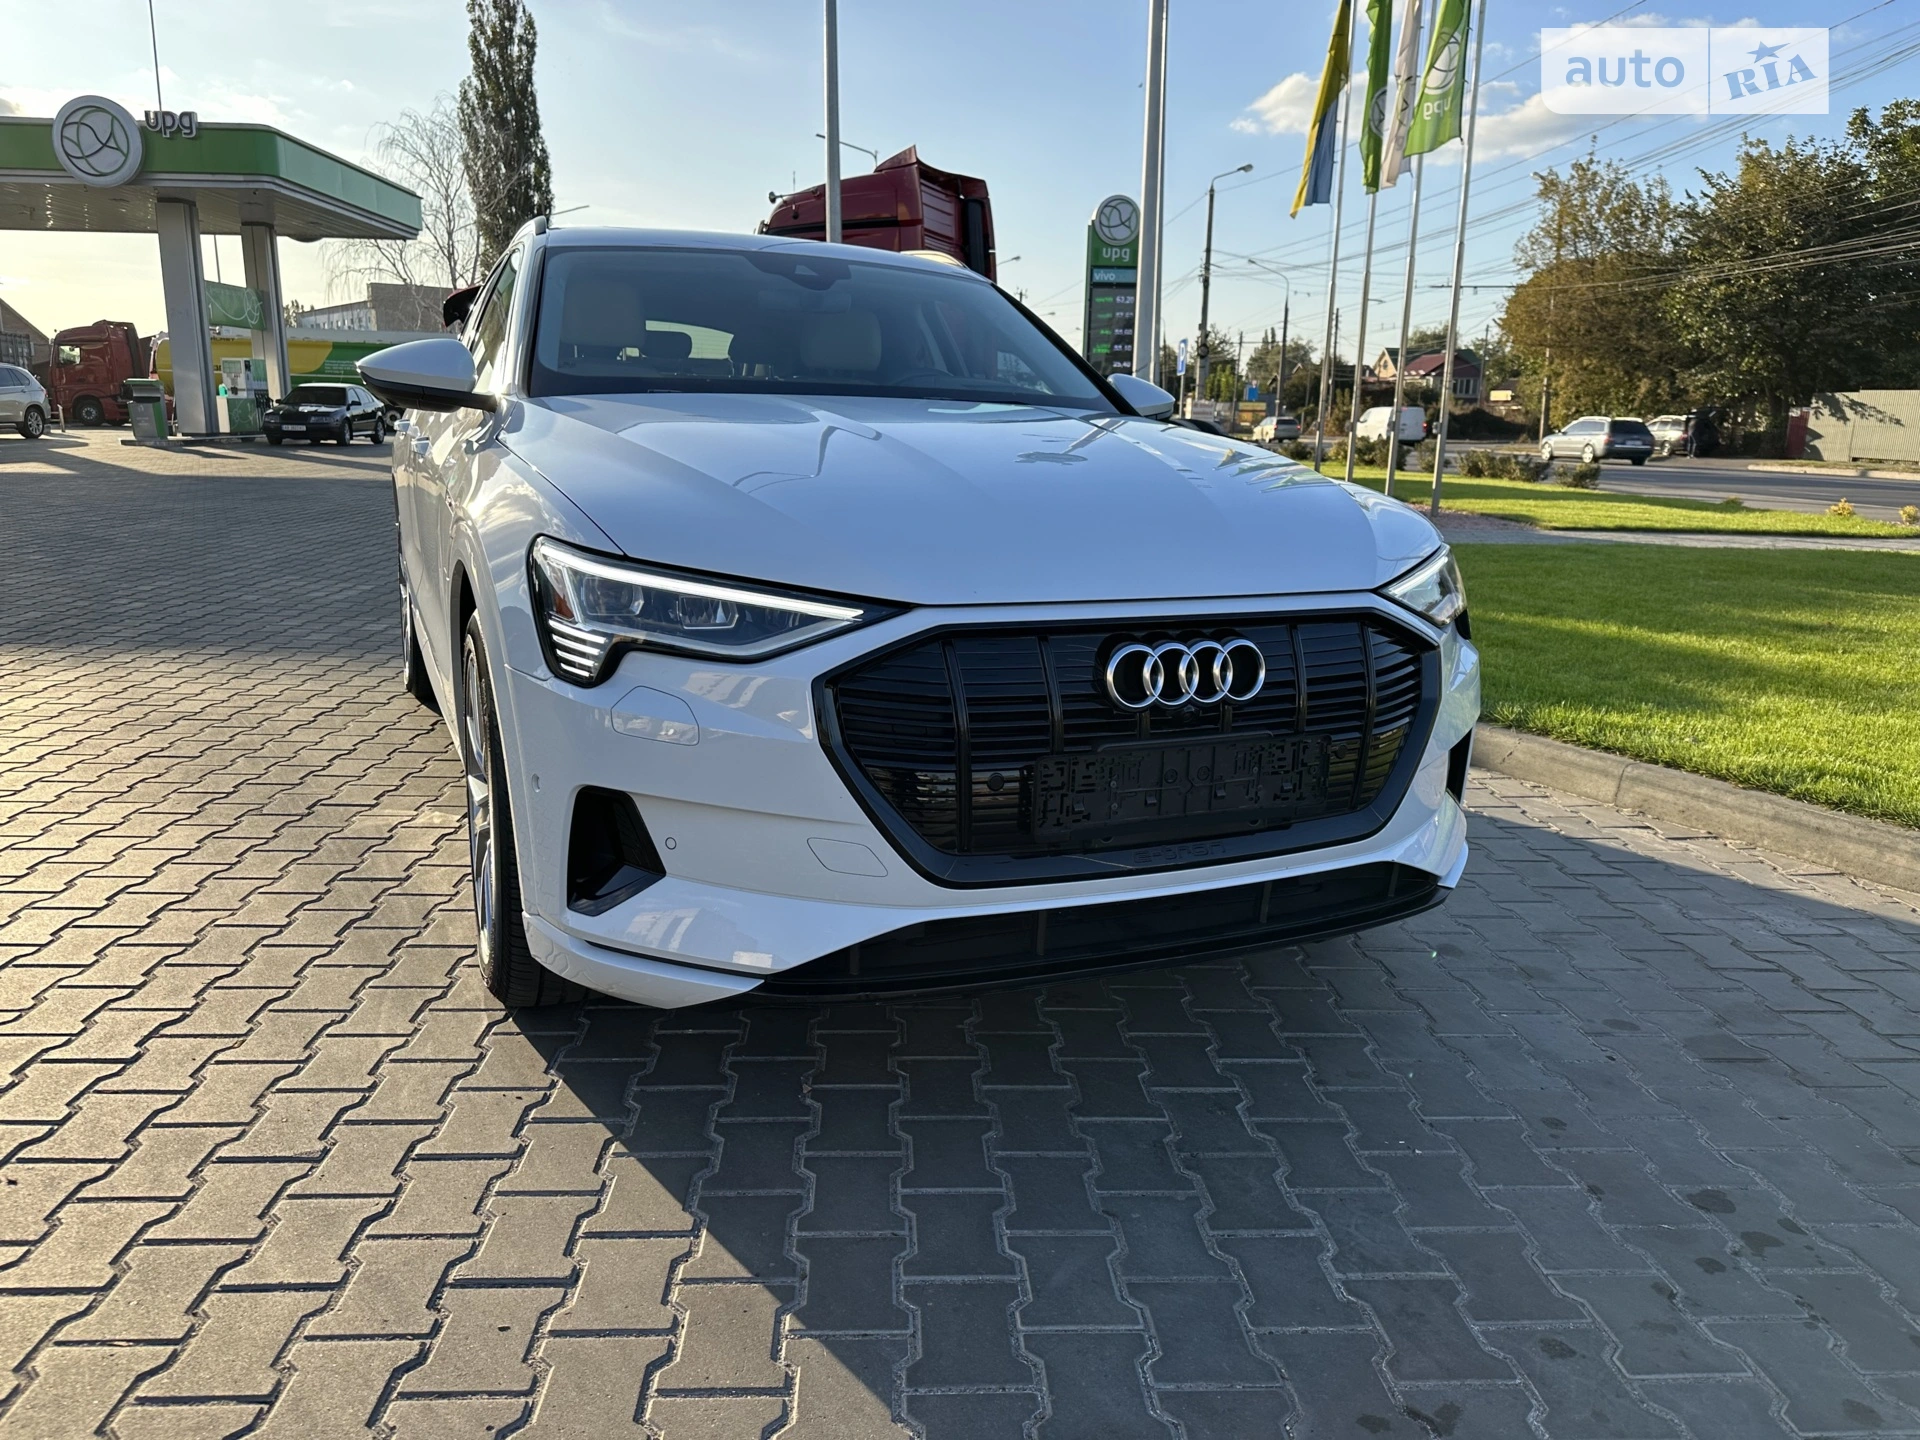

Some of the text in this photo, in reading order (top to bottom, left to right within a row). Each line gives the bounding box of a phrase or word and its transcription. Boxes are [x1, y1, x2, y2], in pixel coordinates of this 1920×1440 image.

[144, 109, 198, 138] upg
[1102, 247, 1130, 262] upg
[1093, 270, 1116, 281] vivo
